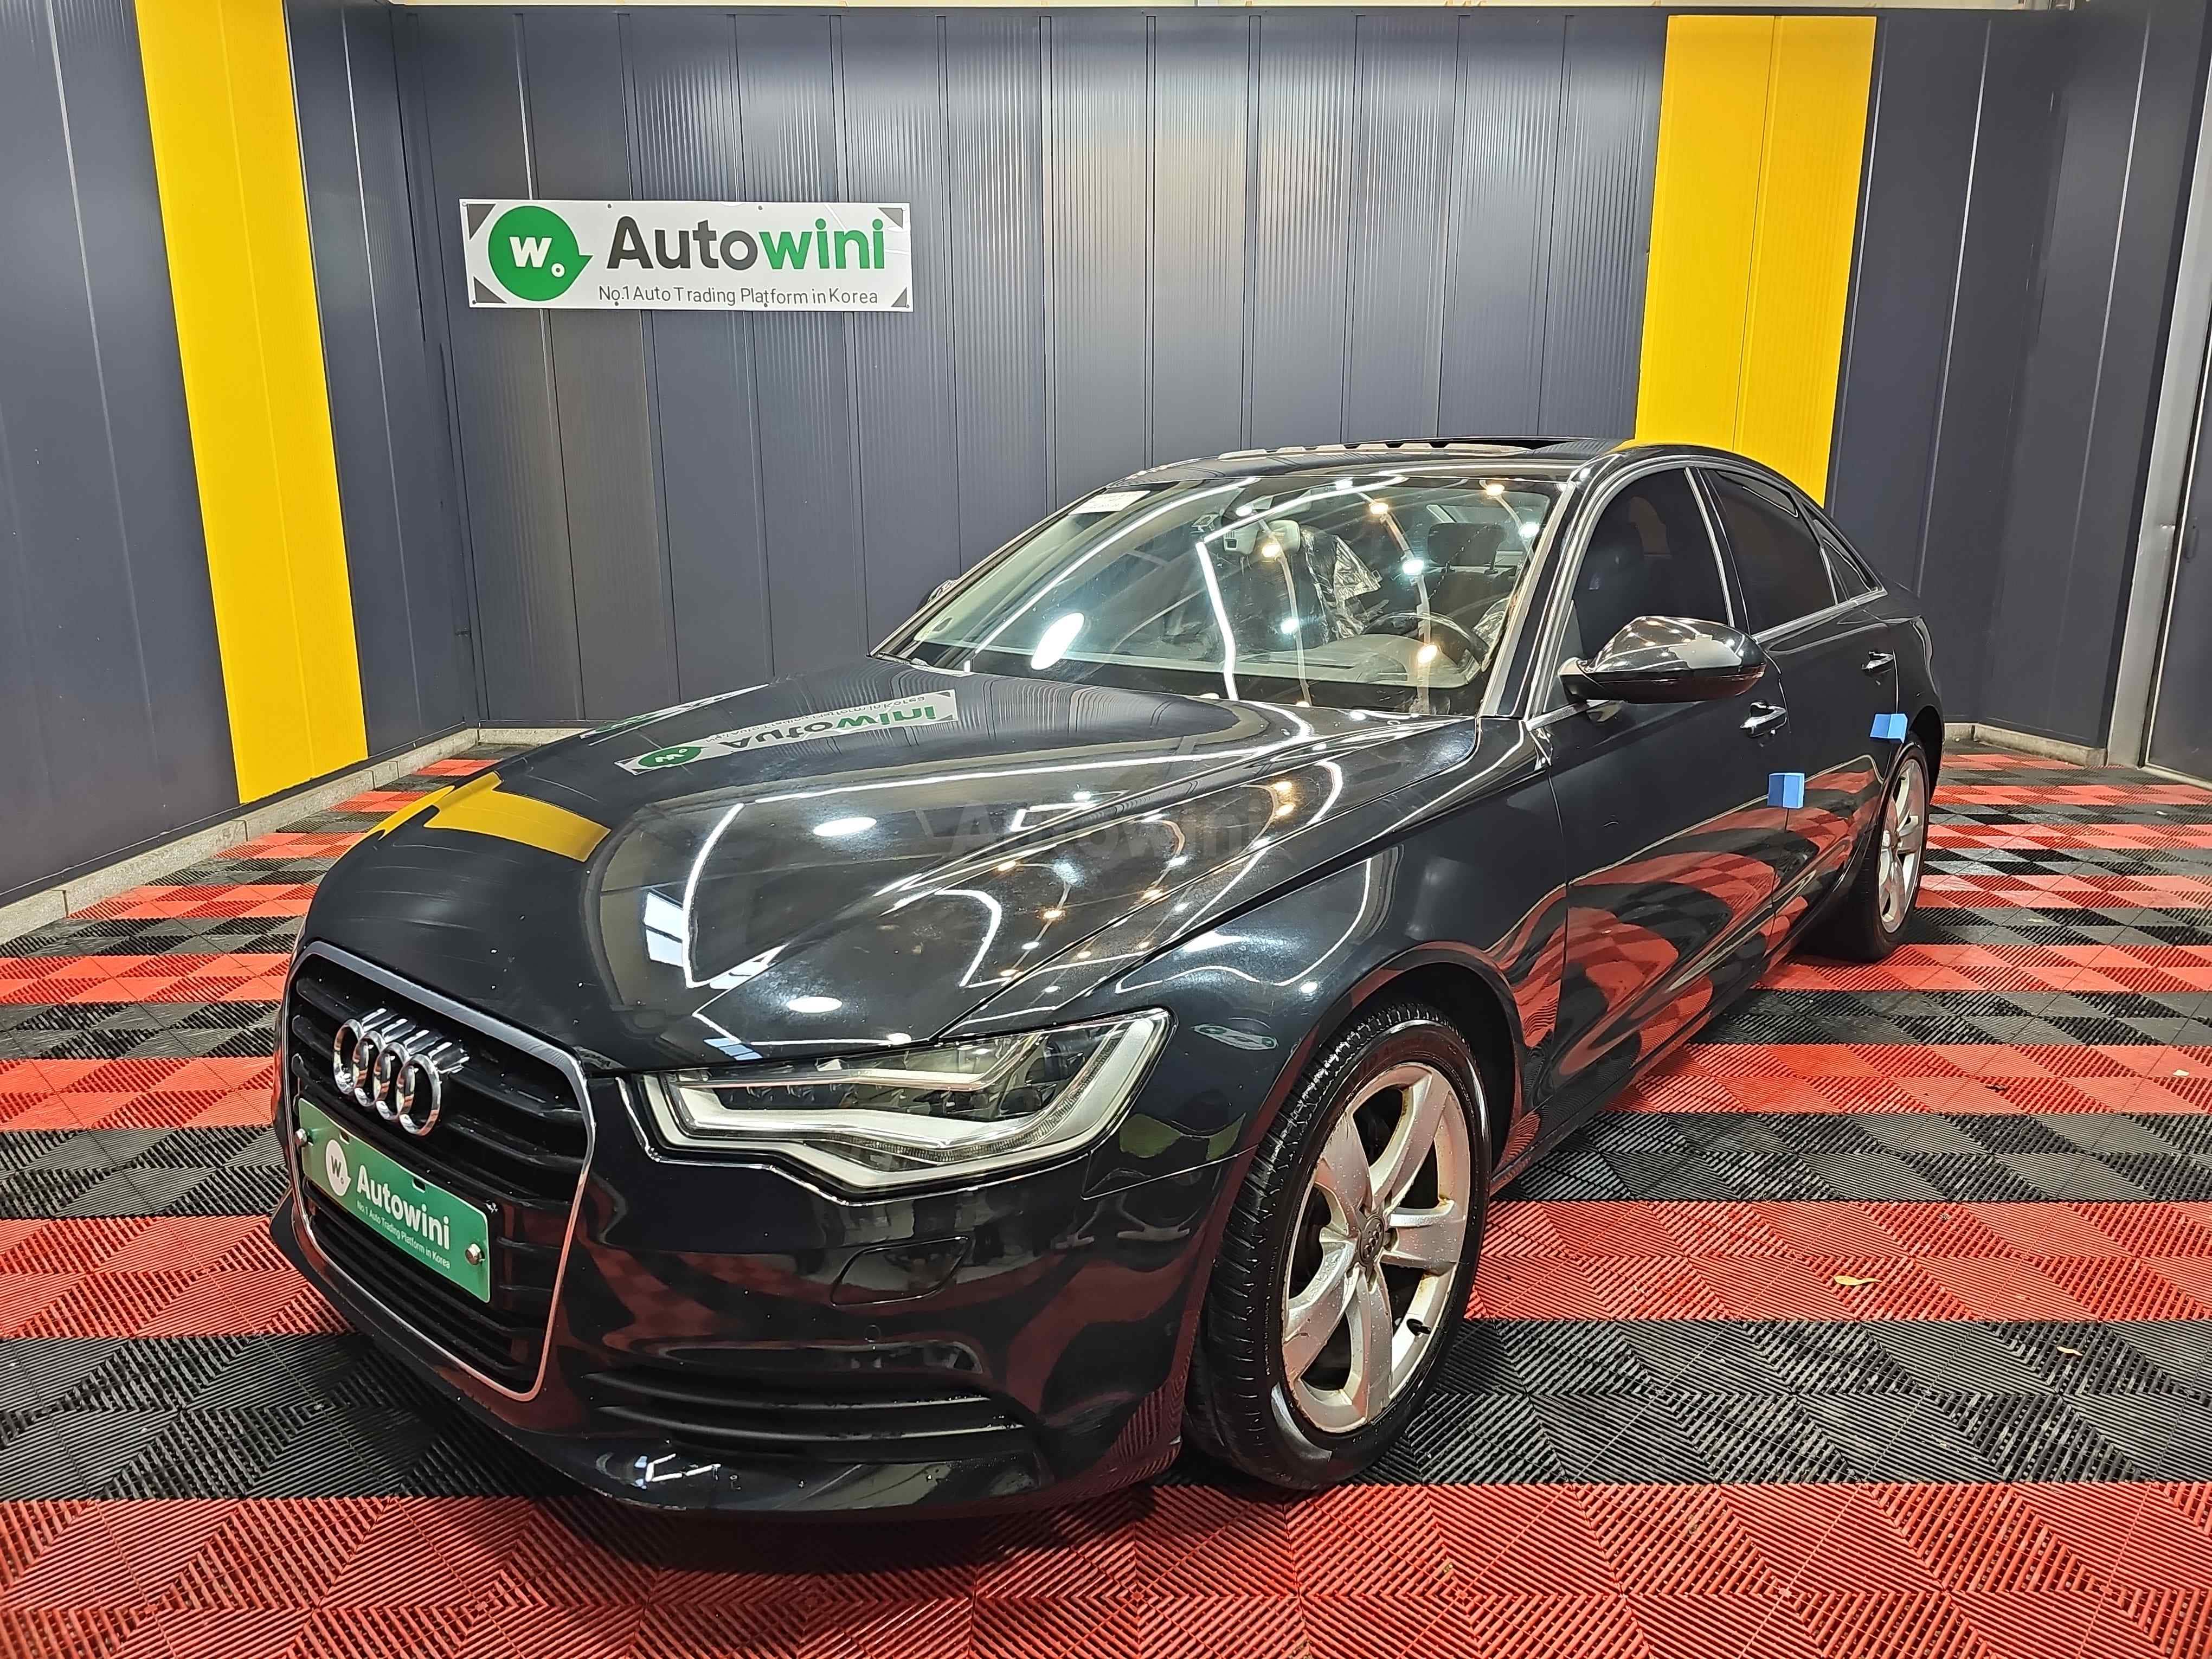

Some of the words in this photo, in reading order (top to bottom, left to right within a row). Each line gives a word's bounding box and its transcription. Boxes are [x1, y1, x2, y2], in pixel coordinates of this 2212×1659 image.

[606, 215, 885, 271] Autowini
[599, 285, 630, 301] No.1
[633, 286, 671, 301] Auto
[673, 286, 736, 306] Trading
[740, 287, 808, 305] Platform
[812, 288, 826, 304] in
[828, 287, 878, 304] Korea
[356, 1164, 451, 1250] Autowini
[357, 1200, 368, 1216] No.1
[369, 1209, 381, 1225] Auto
[381, 1217, 401, 1240] Trading
[401, 1230, 426, 1253] Platform
[426, 1246, 432, 1259] in
[432, 1250, 451, 1270] Korea
